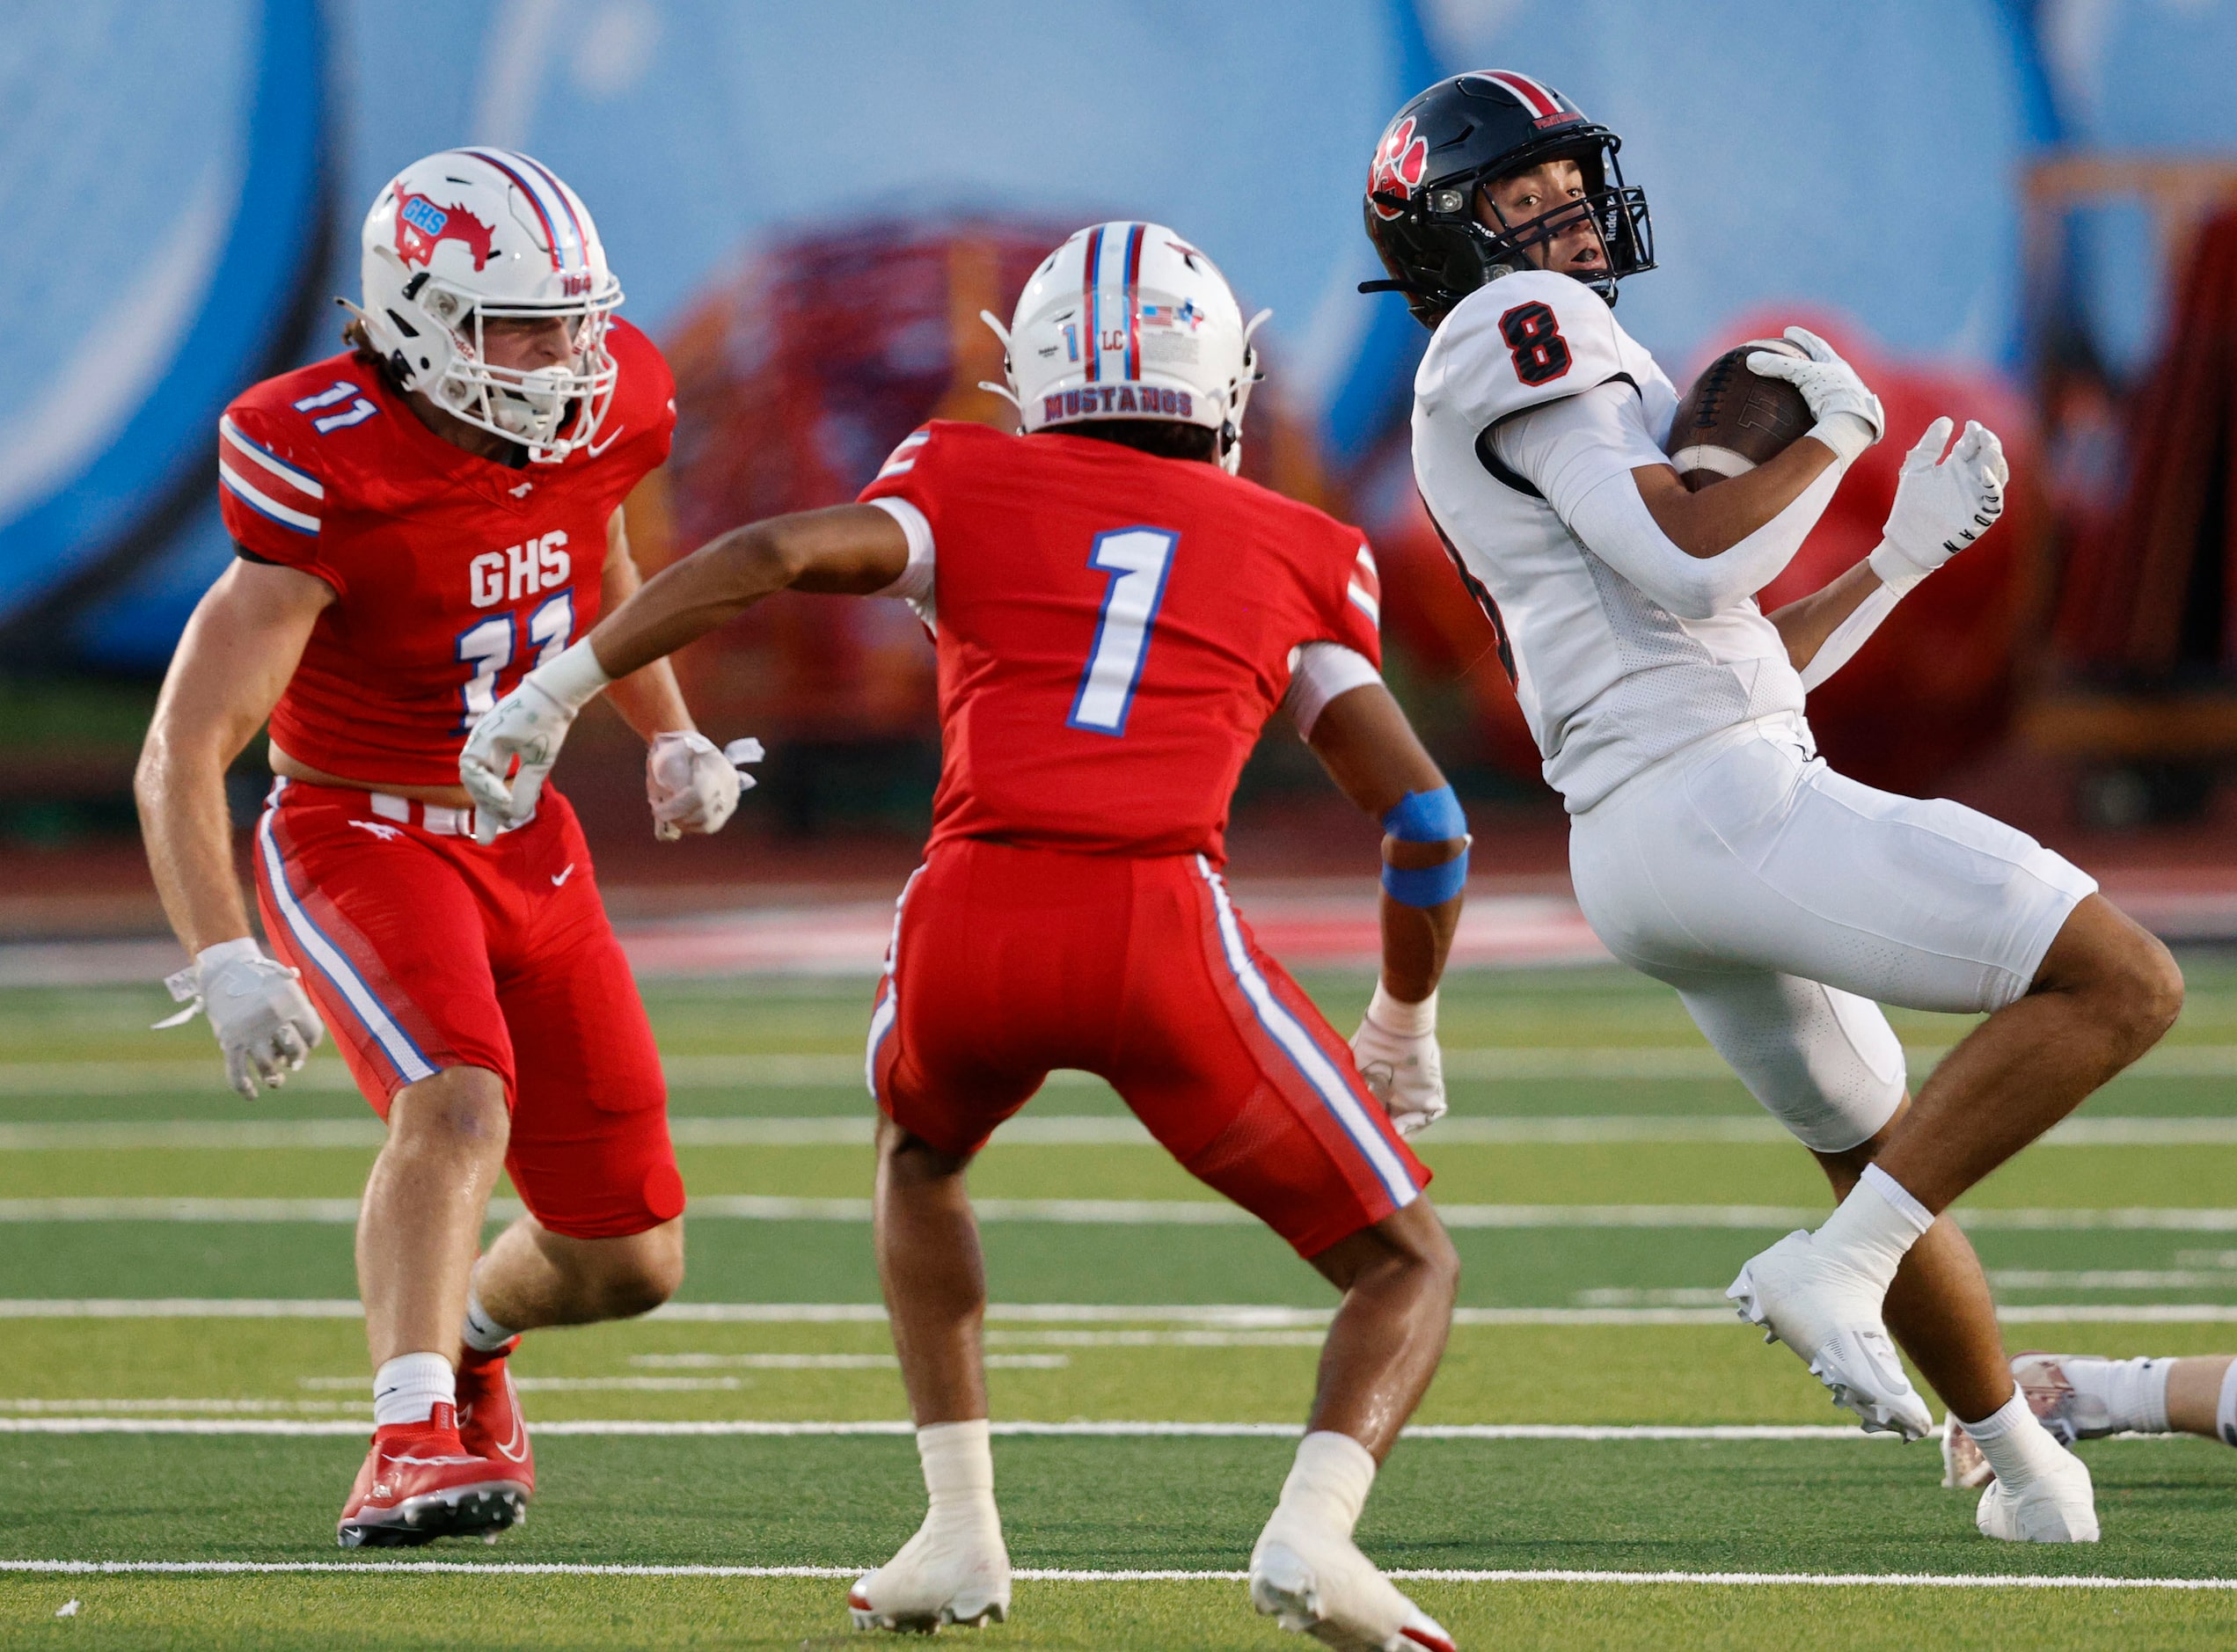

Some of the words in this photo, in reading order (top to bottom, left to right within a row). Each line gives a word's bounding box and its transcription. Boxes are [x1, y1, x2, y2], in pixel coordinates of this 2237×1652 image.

[402, 196, 448, 236] GHS
[1063, 324, 1078, 362] 1
[1101, 330, 1124, 351] LC
[1498, 300, 1573, 388] 8
[292, 380, 381, 436] 11
[1043, 385, 1192, 422] MUSTANGS
[470, 530, 571, 609] GHS
[1065, 524, 1181, 737] 1
[449, 585, 576, 738] 11
